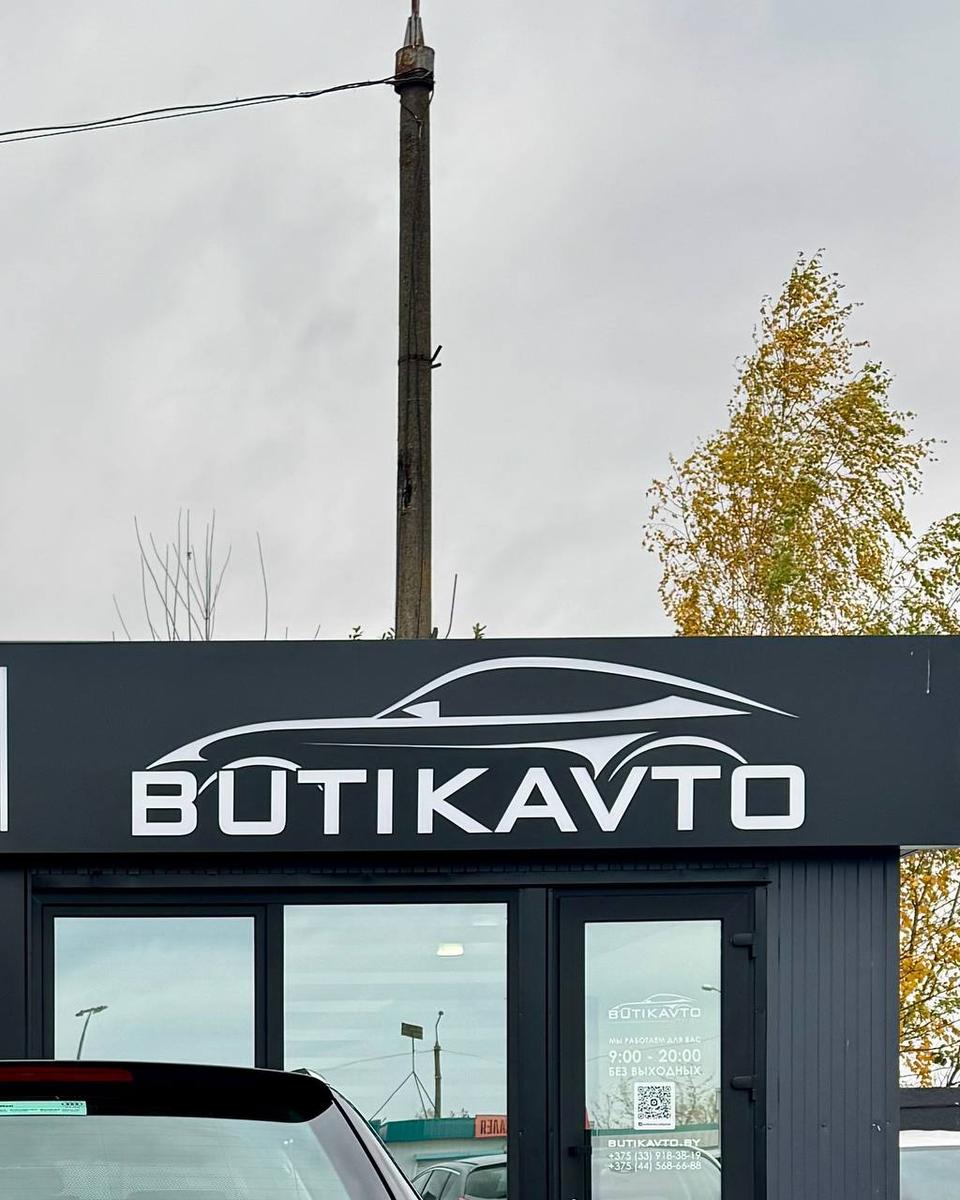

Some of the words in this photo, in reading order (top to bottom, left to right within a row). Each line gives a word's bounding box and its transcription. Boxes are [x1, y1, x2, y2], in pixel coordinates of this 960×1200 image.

[131, 764, 806, 836] BUTIKAVTO
[608, 1008, 701, 1019] BUTIKAVTO
[609, 1050, 642, 1064] 9:00
[658, 1049, 701, 1063] 20:00
[608, 1066, 628, 1077] БЕЗ
[632, 1065, 702, 1077] ВЫХОДНЫХ
[608, 1139, 702, 1148] BUTIKAVTO.BY
[608, 1152, 632, 1160] +375
[634, 1151, 653, 1162] (33)
[655, 1151, 701, 1160] 918-38-19
[608, 1162, 632, 1171] +375
[634, 1161, 653, 1172] (44)
[655, 1161, 702, 1170] 568-66-88
